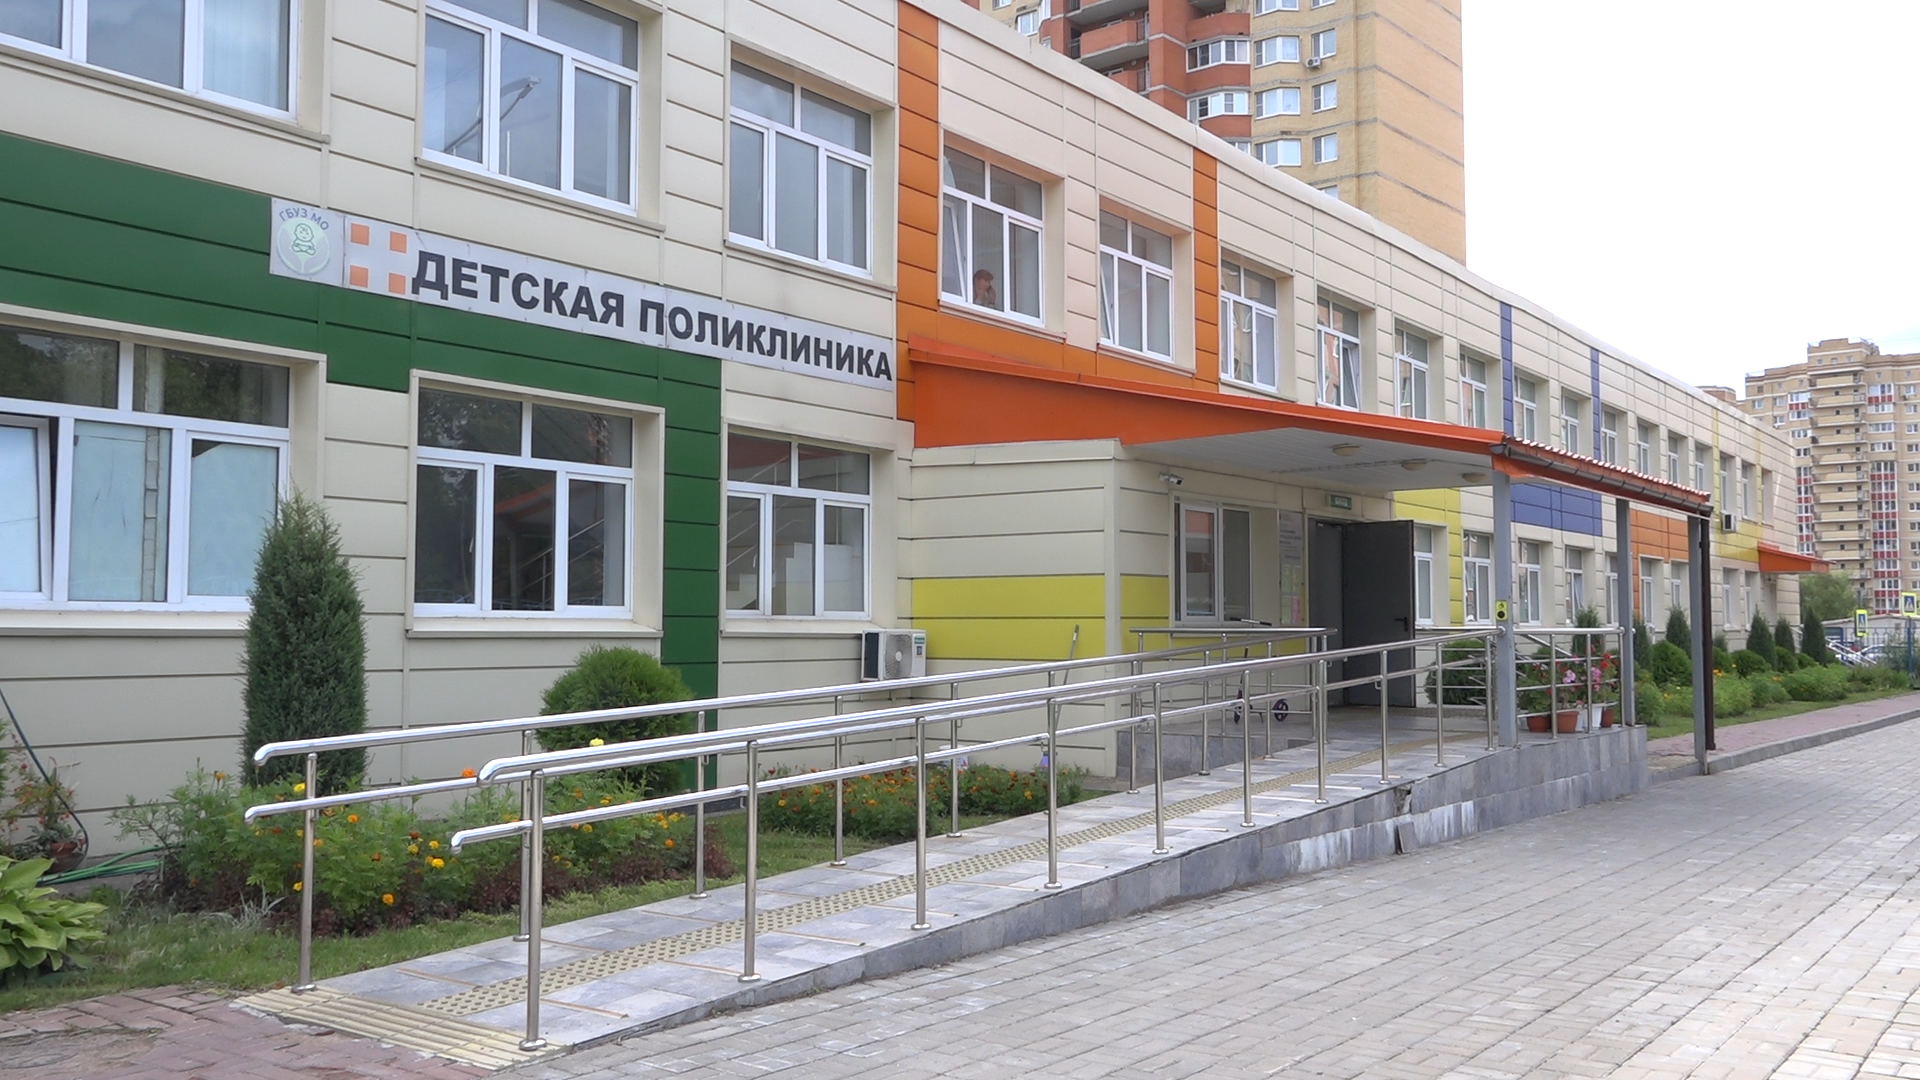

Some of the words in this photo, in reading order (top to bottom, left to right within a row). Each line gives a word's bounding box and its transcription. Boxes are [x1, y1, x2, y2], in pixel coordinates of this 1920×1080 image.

[279, 207, 308, 222] ГБУЗ
[311, 212, 329, 230] МО
[411, 250, 624, 327] ДЕТСКАЯ
[639, 299, 892, 381] ПОЛИКЛИНИКА
